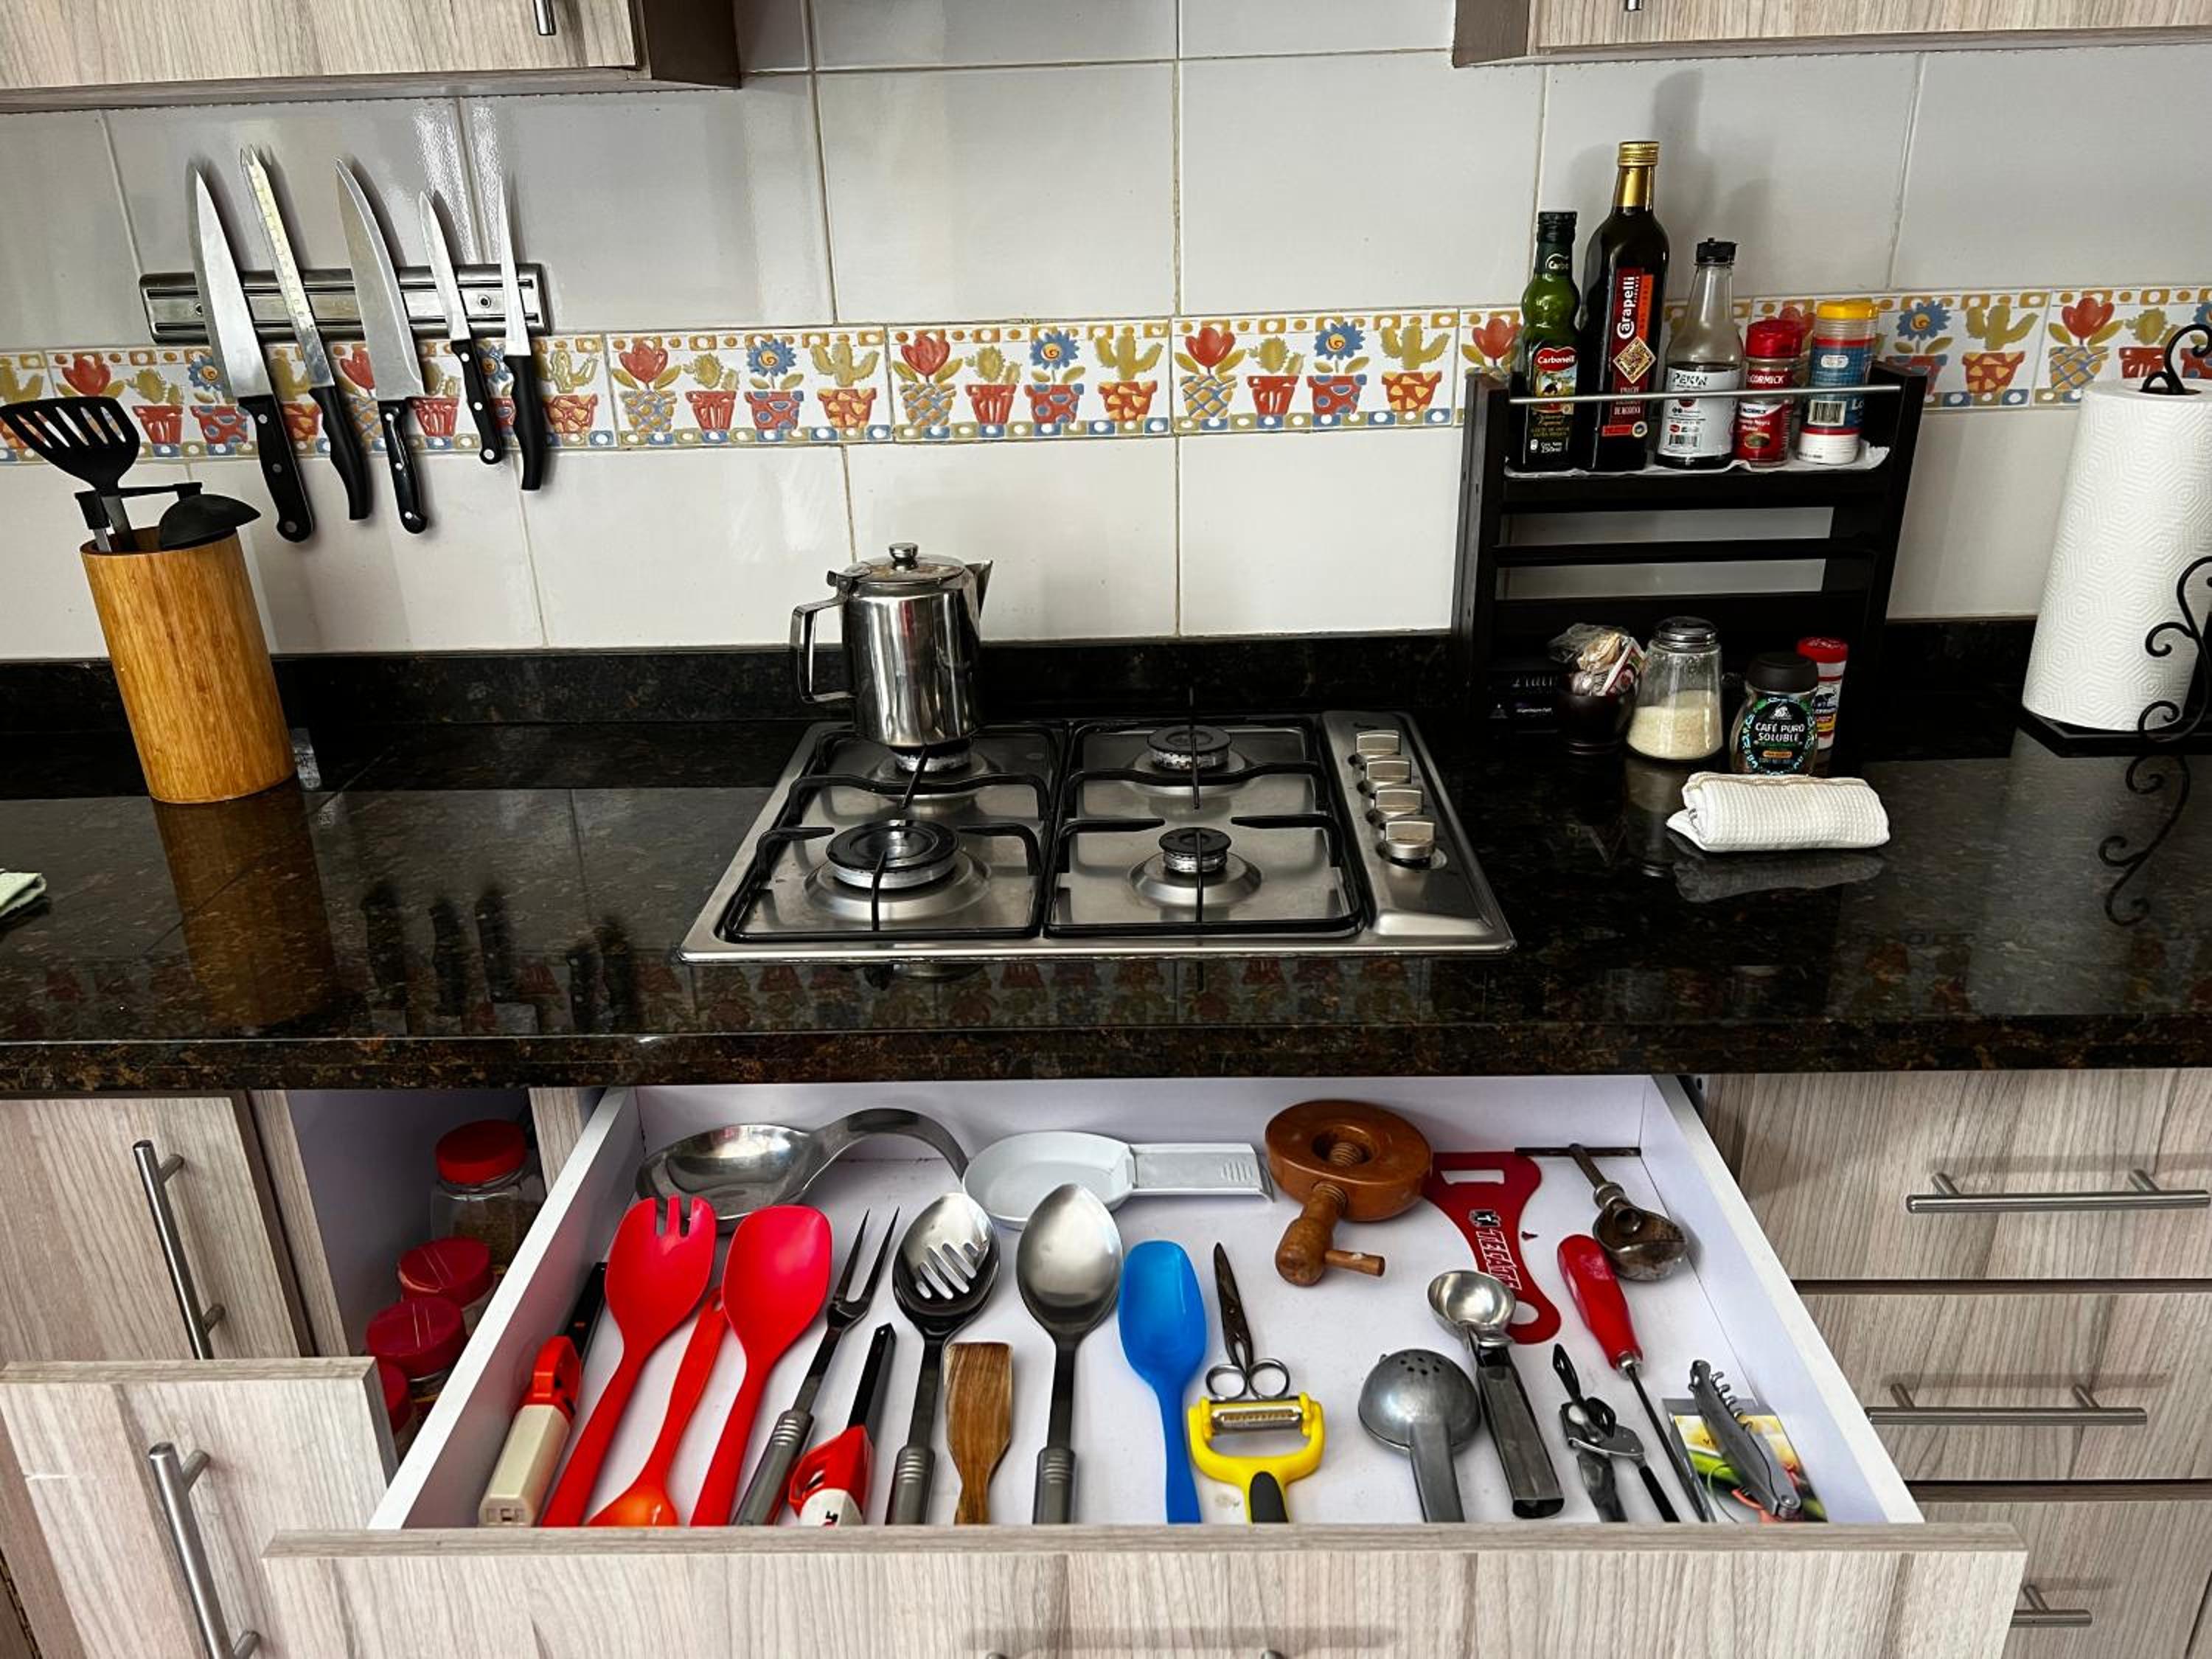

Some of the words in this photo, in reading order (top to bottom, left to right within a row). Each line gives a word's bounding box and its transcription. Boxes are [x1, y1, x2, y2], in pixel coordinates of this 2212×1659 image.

[1616, 276, 1636, 339] Carapelli
[1537, 355, 1576, 364] Carbonell
[1672, 372, 1708, 386] PEKIN
[1781, 723, 1806, 732] PURO
[1759, 732, 1799, 742] SOLUBLE
[1475, 1228, 1523, 1291] TECATE
